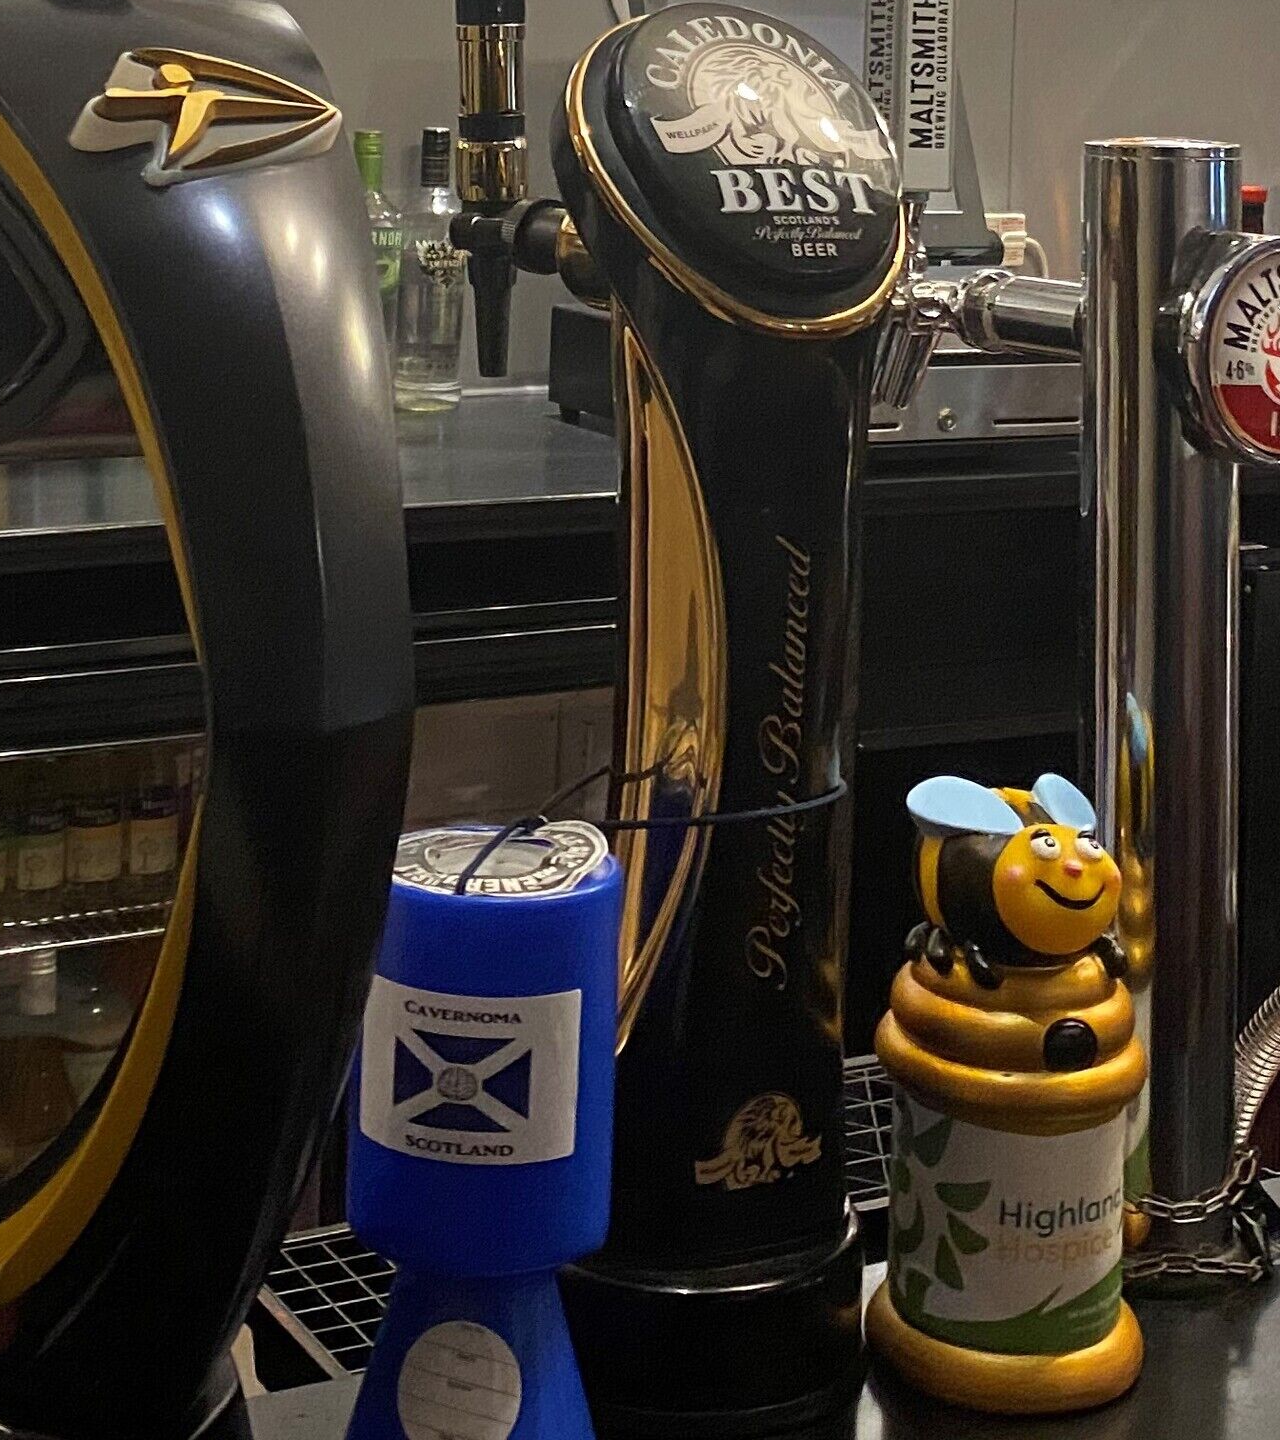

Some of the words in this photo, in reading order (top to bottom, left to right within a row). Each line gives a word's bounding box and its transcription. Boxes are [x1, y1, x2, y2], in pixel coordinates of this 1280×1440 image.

[646, 15, 850, 102] CALEDONIA
[935, 90, 947, 150] BREWING
[710, 168, 876, 216] BEST
[773, 215, 840, 226] SCOTLAND'S
[792, 242, 838, 257] BEER
[757, 534, 812, 785] Balanced
[404, 998, 522, 1026] CAVERNOMA
[404, 1133, 515, 1158] SCOTLAND
